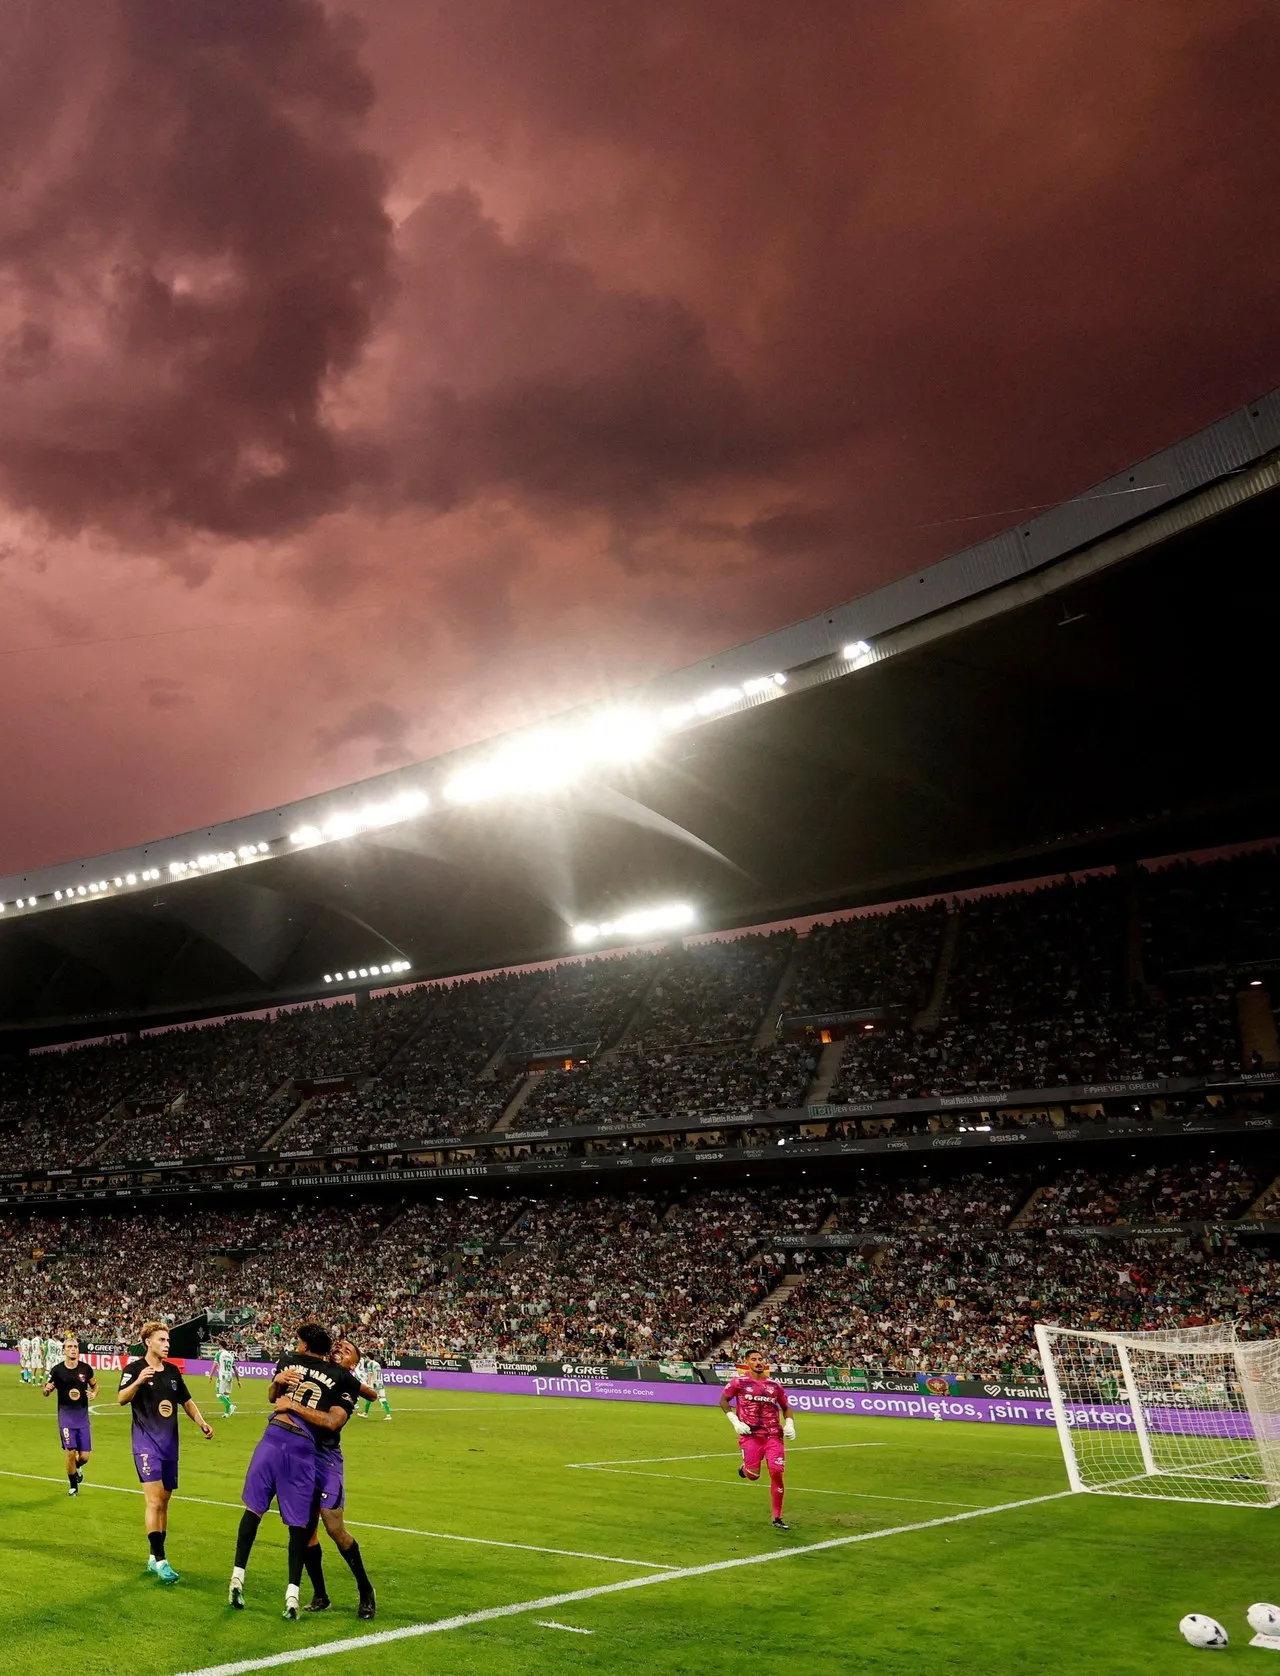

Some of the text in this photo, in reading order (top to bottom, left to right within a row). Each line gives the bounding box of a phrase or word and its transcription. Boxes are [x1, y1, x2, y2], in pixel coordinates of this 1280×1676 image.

[1084, 1082, 1160, 1094] FOREVER GREEN
[79, 1354, 123, 1370] ALIGA
[494, 1361, 537, 1372] Cruzcampo
[237, 1366, 268, 1376] guros
[280, 1365, 336, 1389] AMINE YAMAL
[576, 1366, 608, 1376] GREE
[380, 1372, 422, 1384] ateos!
[532, 1377, 592, 1395] prima
[595, 1387, 622, 1395] Seguros
[886, 1382, 919, 1392] CaixaB
[1004, 1386, 1067, 1399] trainlie
[787, 1395, 1153, 1427] eguros completos, ¡sin regateo!
[63, 1428, 70, 1440] 8
[141, 1453, 148, 1466] 7
